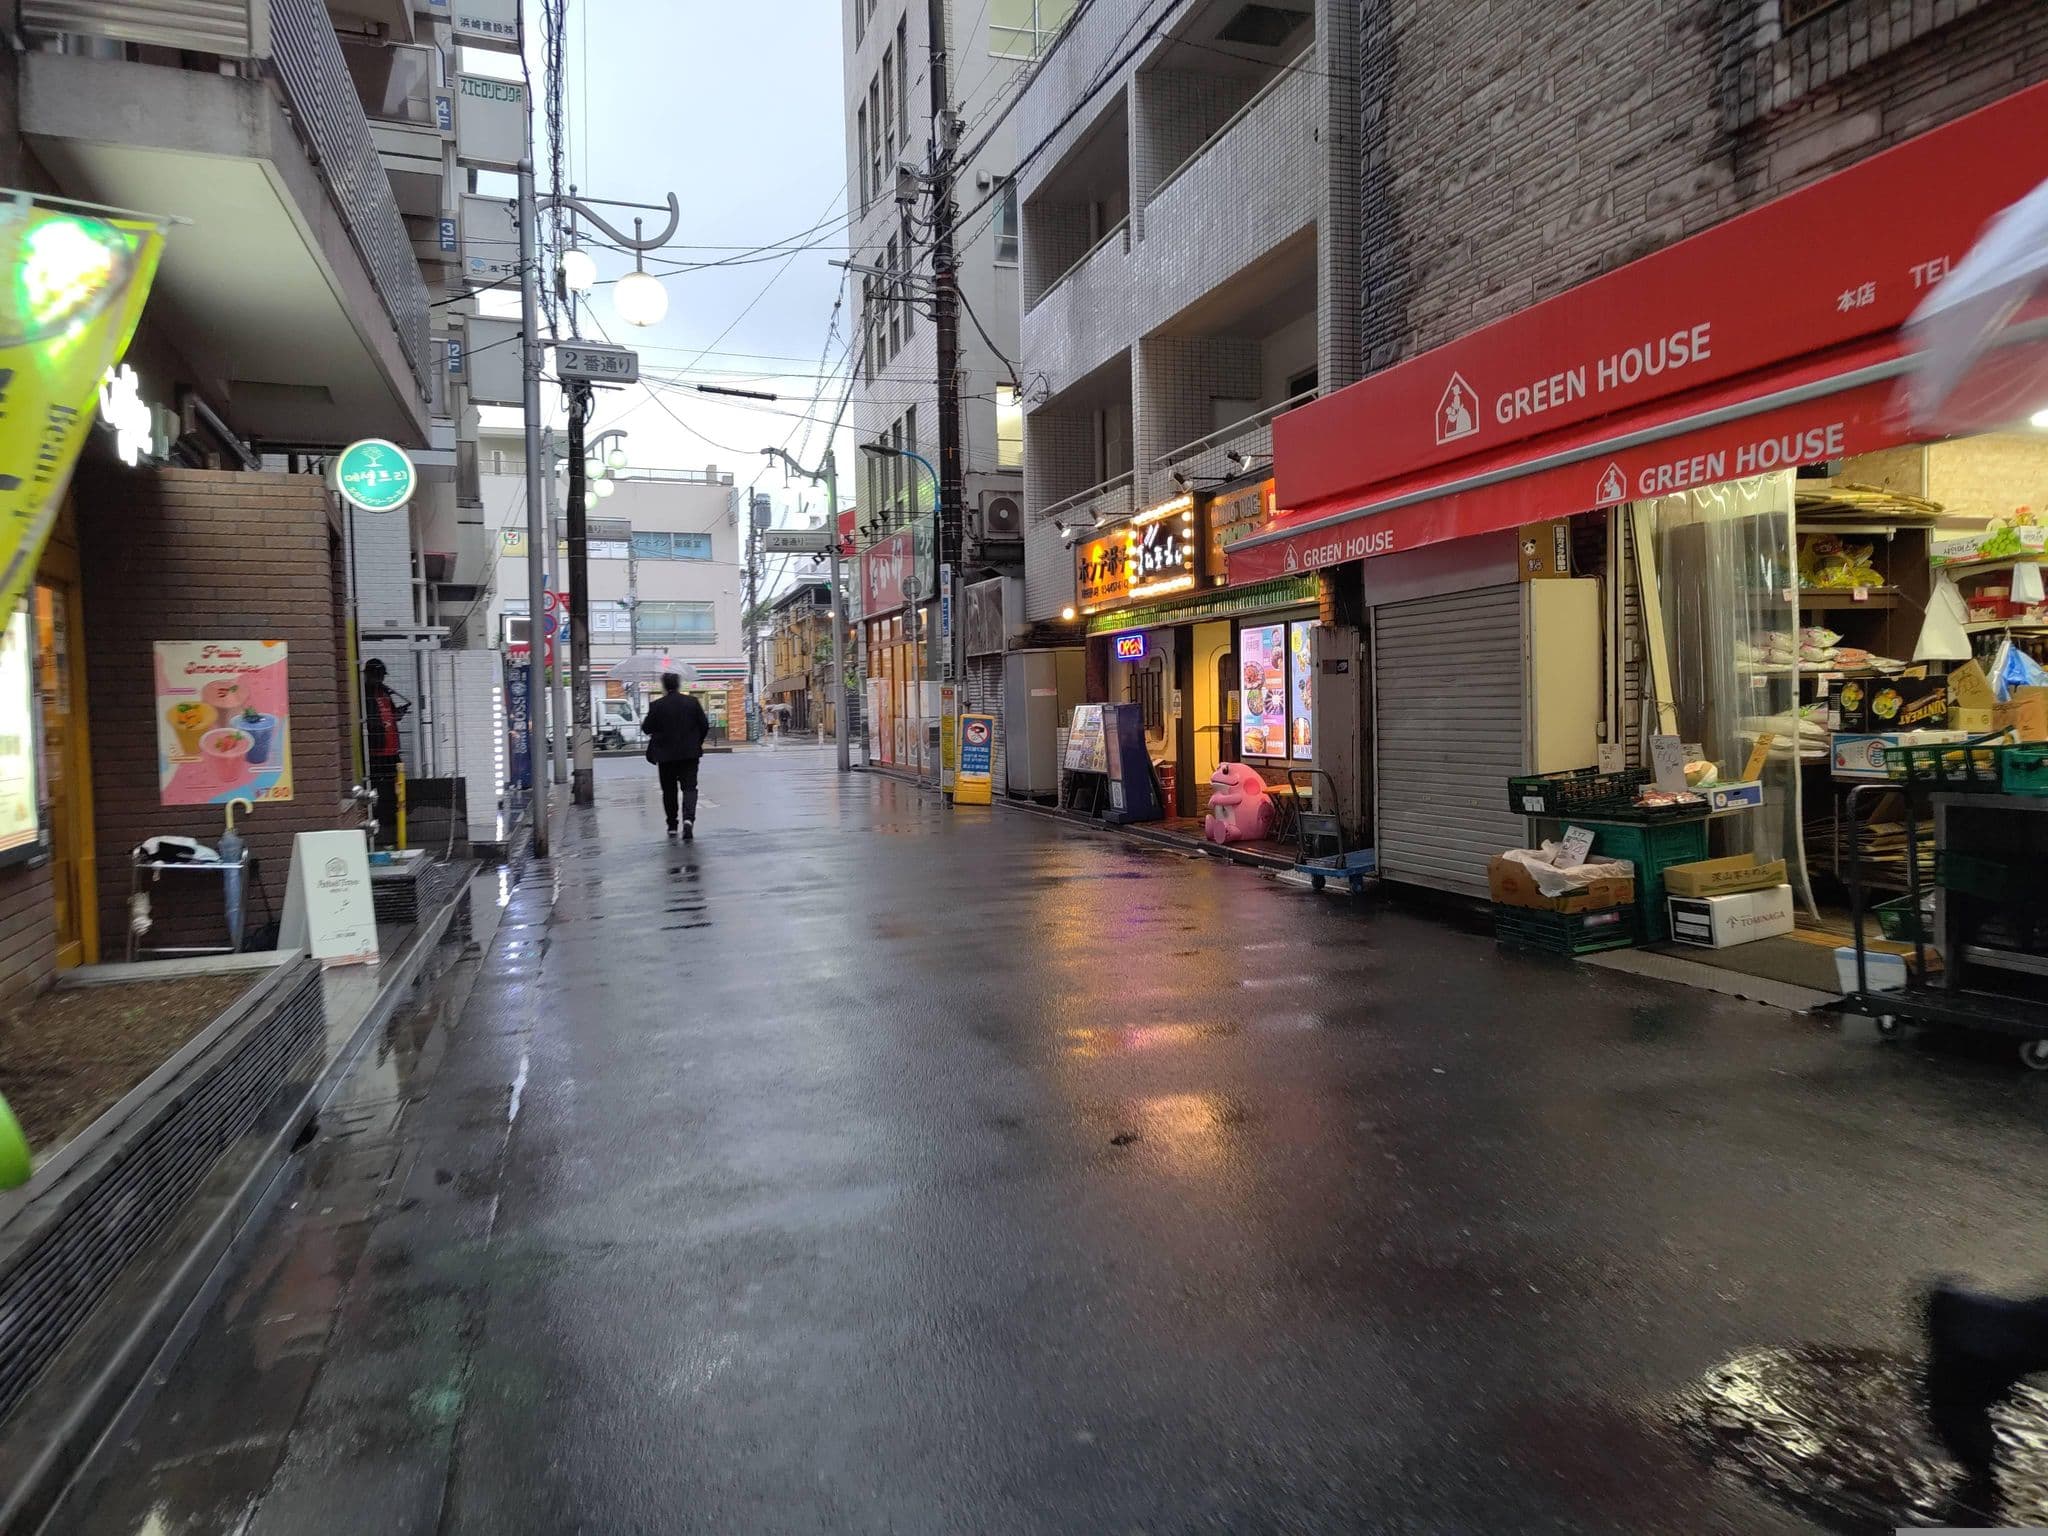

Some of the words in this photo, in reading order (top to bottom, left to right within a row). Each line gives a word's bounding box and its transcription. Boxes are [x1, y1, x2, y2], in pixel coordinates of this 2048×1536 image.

[1908, 255, 1952, 289] TEL
[1837, 281, 1877, 312] 本店
[564, 351, 631, 374] 2番通り
[1495, 364, 1587, 425] GREEN
[1597, 321, 1712, 393] HOUSE
[1638, 450, 1726, 495] GREEN
[1735, 422, 1845, 474] HOUSE
[1303, 541, 1343, 568] GREEN
[1346, 529, 1395, 557] HOUSE
[1119, 637, 1141, 656] OPEN
